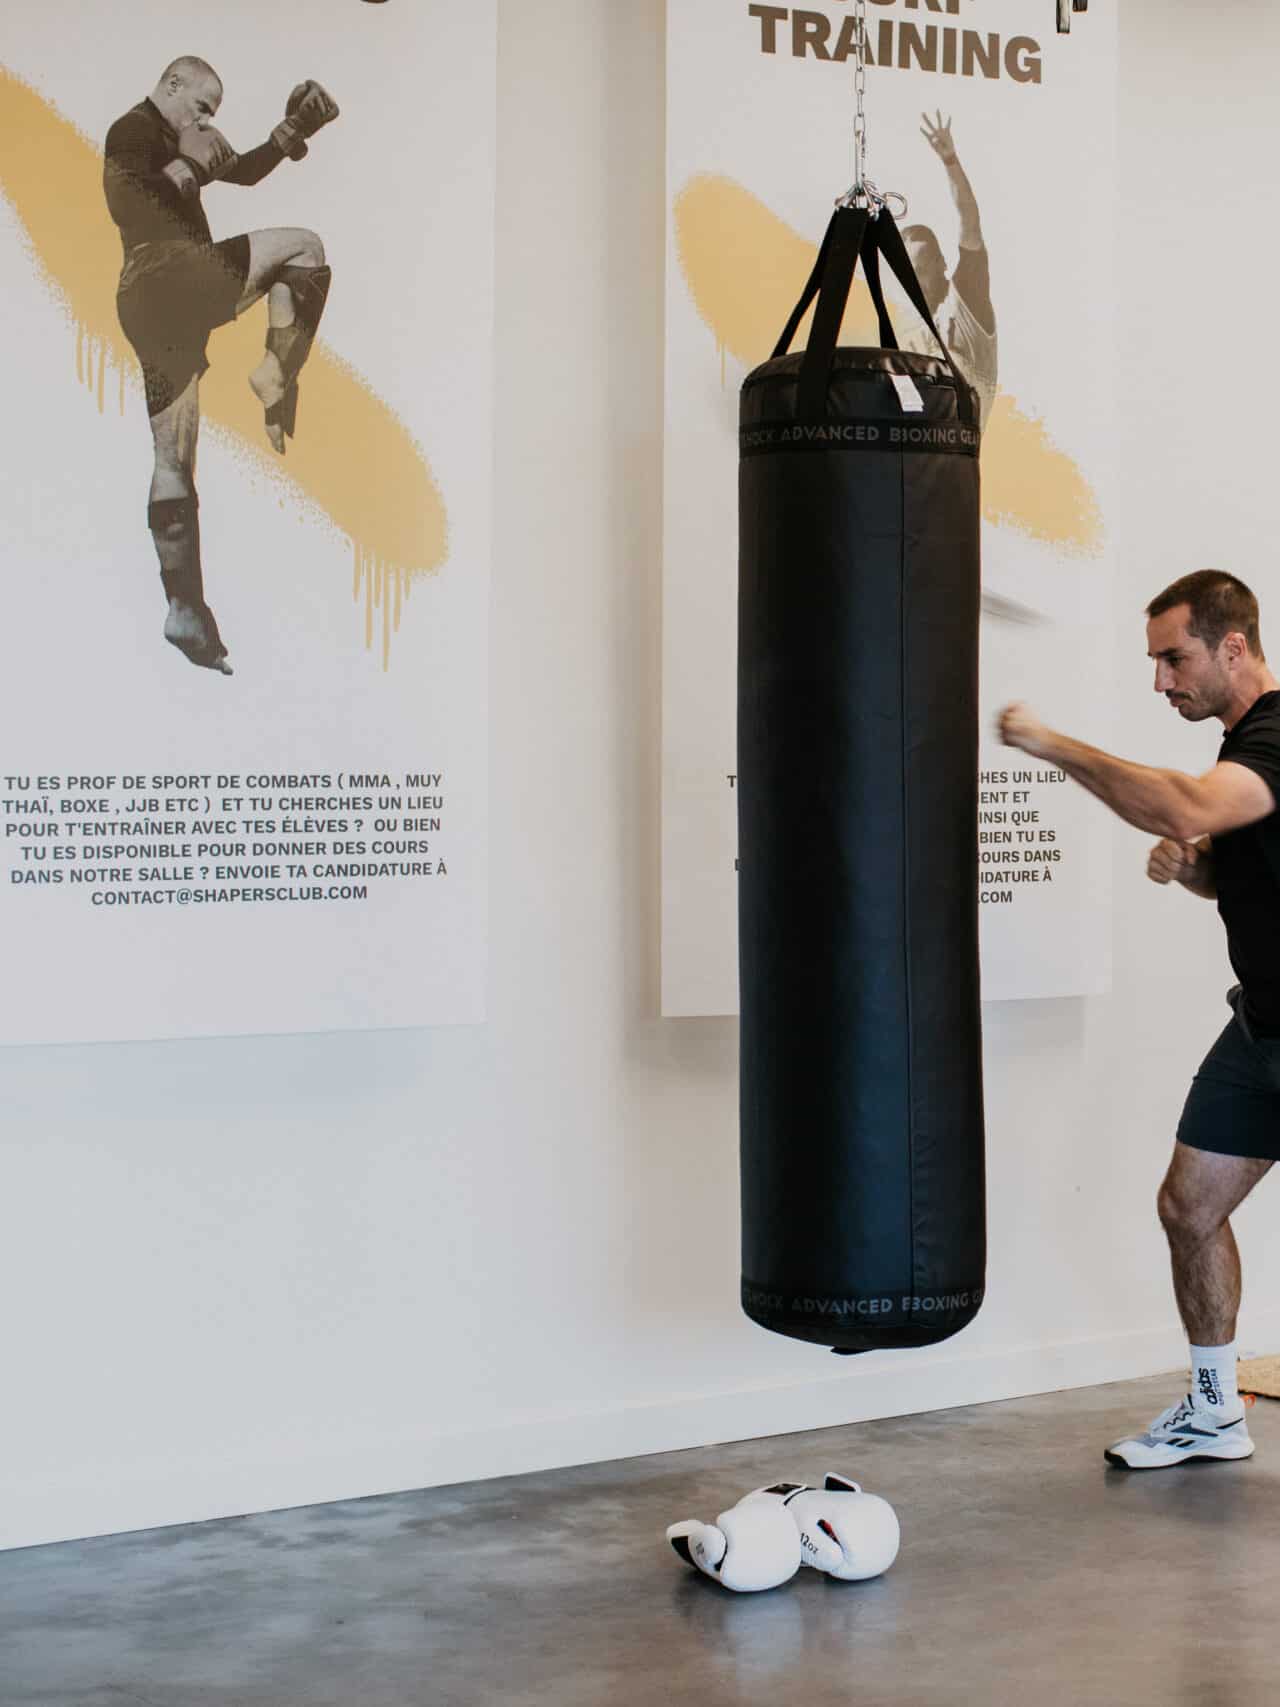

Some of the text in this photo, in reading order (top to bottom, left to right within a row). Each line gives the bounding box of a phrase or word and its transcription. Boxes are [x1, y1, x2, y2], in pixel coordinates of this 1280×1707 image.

[748, 4, 1041, 84] TRAINING
[781, 425, 879, 441] ADVANCED
[4, 776, 30, 790] TU
[38, 776, 60, 790] ES
[68, 776, 116, 789] PROF
[123, 776, 146, 789] DE
[152, 776, 211, 789] SPORT
[217, 776, 240, 788] DE
[246, 775, 331, 788] COMBATS
[350, 775, 391, 787] MMA
[406, 775, 441, 787] MUY
[981, 772, 1008, 783] HES
[1013, 771, 1032, 783] UN
[1037, 771, 1066, 783] LIEU
[61, 800, 109, 813] BOXE
[126, 799, 159, 812] JJB
[166, 798, 198, 812] ETC
[222, 798, 244, 811] ET
[249, 798, 272, 810] TU
[279, 797, 372, 810] CHERCHES
[379, 797, 401, 809] UN
[408, 797, 442, 809] LIEU
[981, 792, 1030, 803] ENT ET
[979, 811, 1039, 825] INSI QUE
[6, 823, 58, 837] POUR
[65, 818, 185, 836] T'ENTRAÎNER
[192, 821, 236, 834] AVEC
[242, 820, 276, 833] TES
[282, 816, 348, 833] ÉLÈVES
[375, 819, 397, 832] OU
[404, 818, 440, 831] BIEN
[980, 831, 1055, 843] BIEN TU ES
[21, 841, 428, 860] TU ES DISPONIBLE POUR DONNER DES COURS
[981, 850, 1061, 863] OURS DANS
[12, 870, 63, 883] DANS
[71, 868, 132, 882] NOTRE
[139, 867, 193, 881] SALLE
[216, 865, 280, 879] ENVOIE
[286, 865, 307, 878] TA
[313, 863, 432, 877] CANDIDATURE
[981, 871, 1039, 883] IDATURE
[92, 886, 367, 905] CONTACT@SHAPERSCLUB.COM
[792, 1299, 893, 1314] ADVANCED
